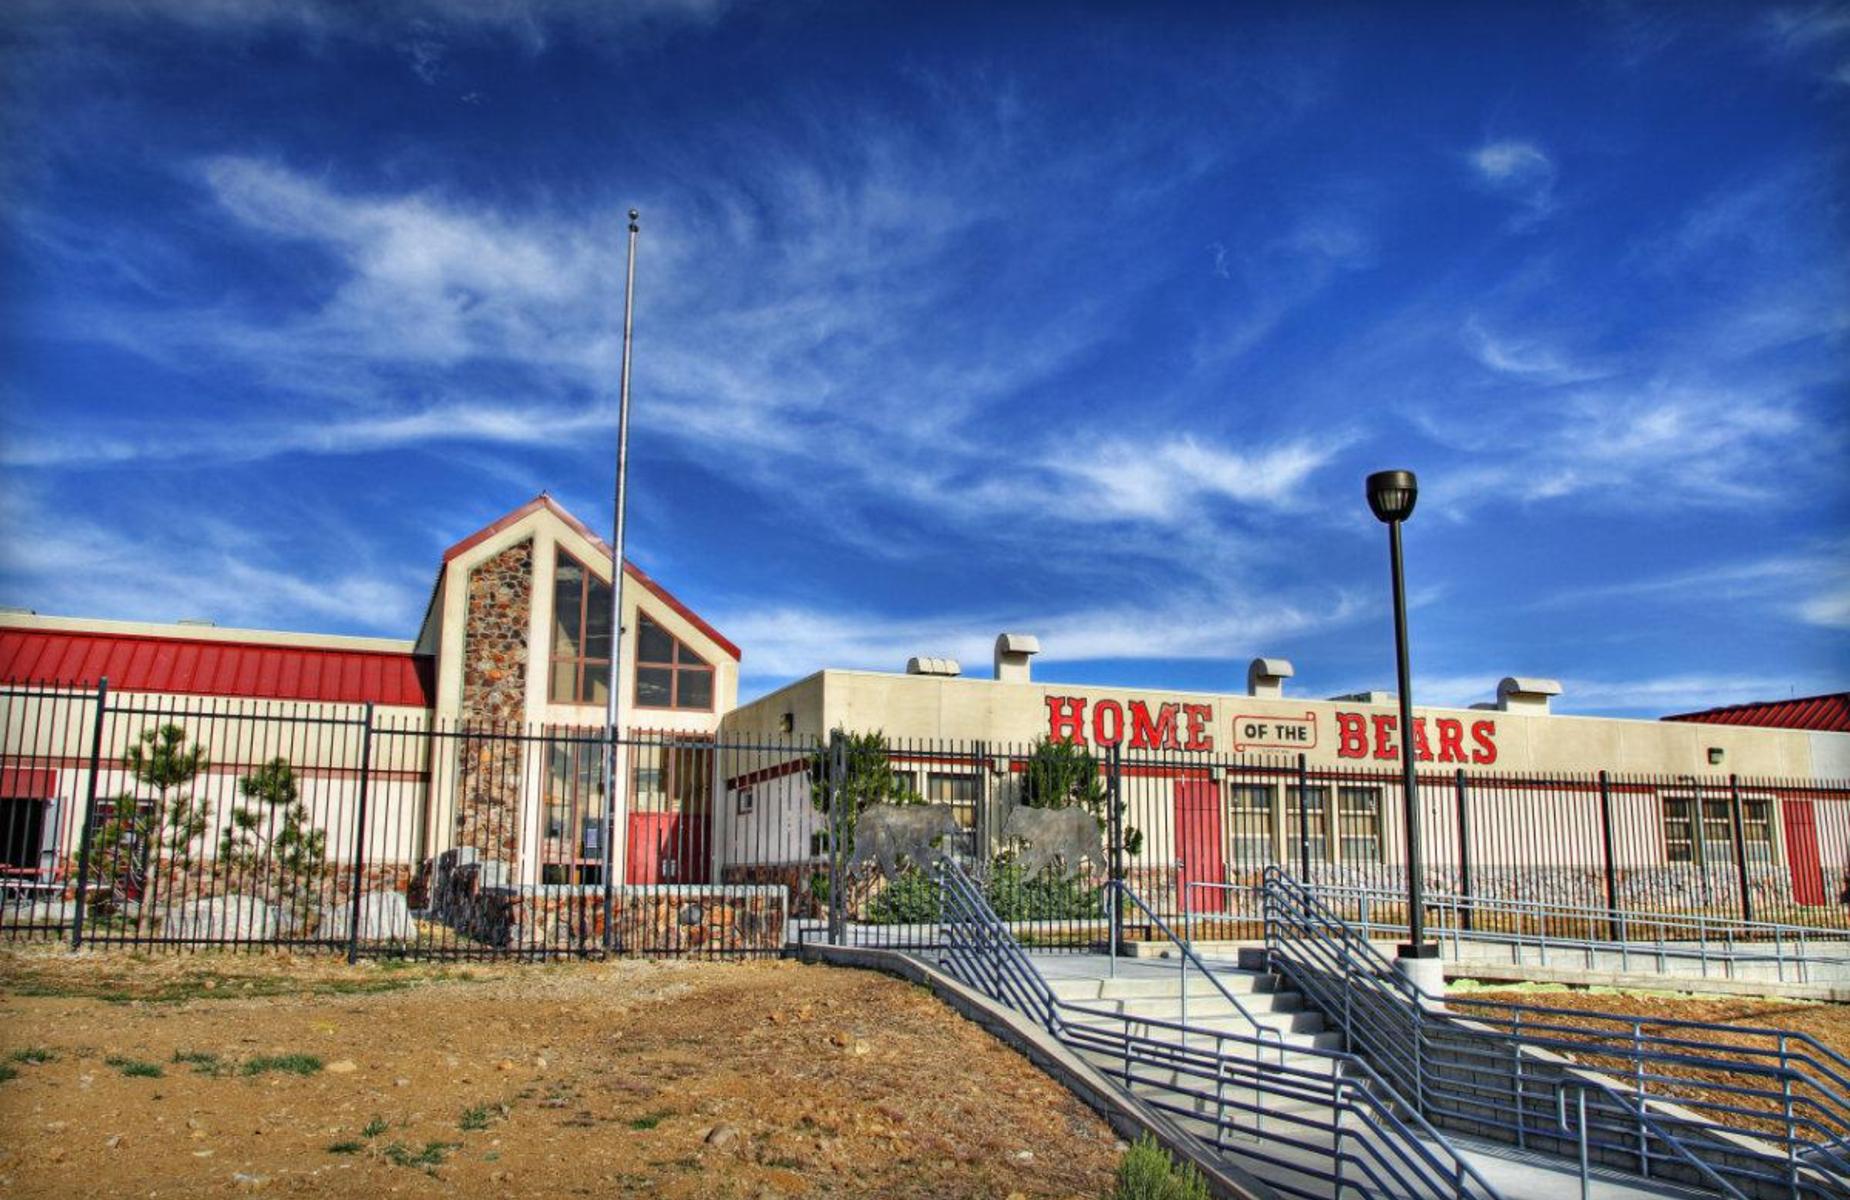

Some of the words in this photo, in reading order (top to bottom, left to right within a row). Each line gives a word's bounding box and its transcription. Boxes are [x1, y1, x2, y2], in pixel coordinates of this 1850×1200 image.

[1045, 695, 1213, 752] HOME
[1244, 723, 1268, 739] OF
[1275, 725, 1307, 741] THE
[1335, 711, 1498, 765] BEARS
